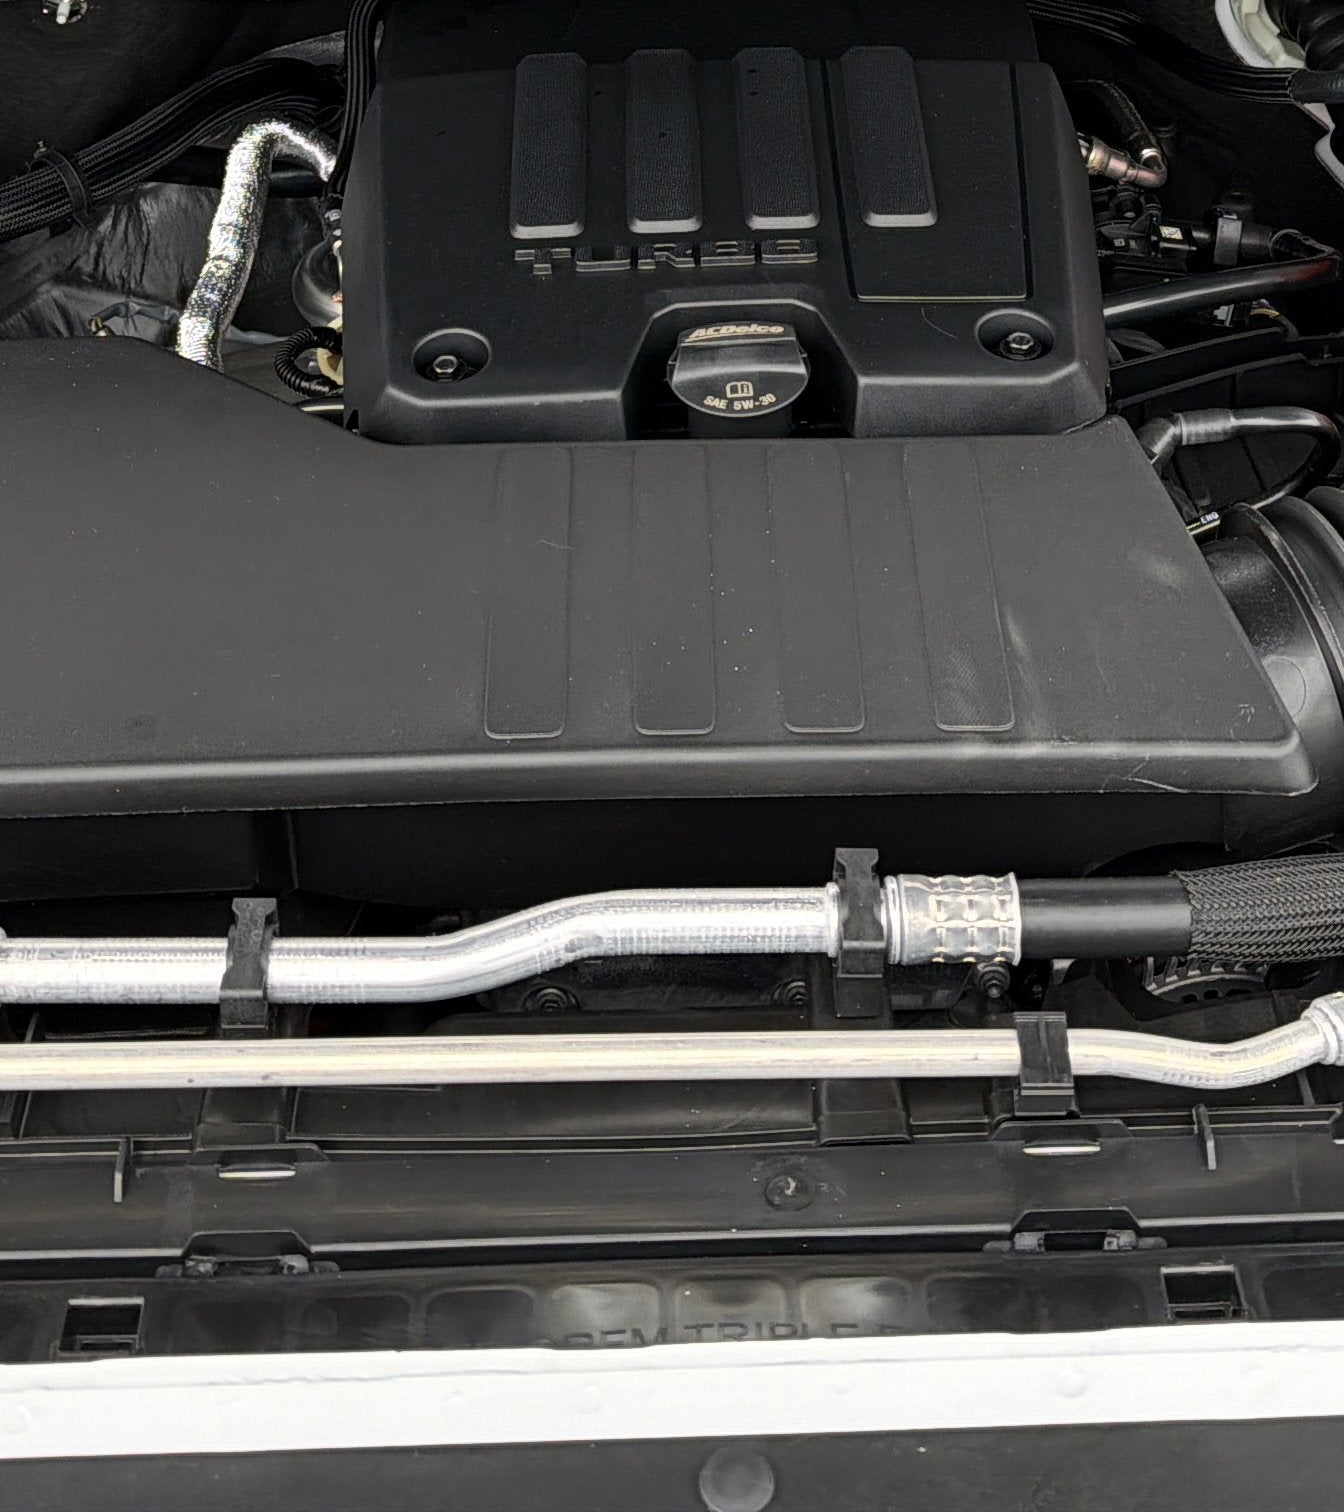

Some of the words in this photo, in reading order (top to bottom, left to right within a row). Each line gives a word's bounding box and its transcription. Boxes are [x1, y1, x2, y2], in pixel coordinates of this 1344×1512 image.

[514, 239, 819, 275] TURBO
[688, 323, 785, 340] ACDelco
[703, 395, 728, 410] SAE
[732, 393, 777, 411] 5W-30
